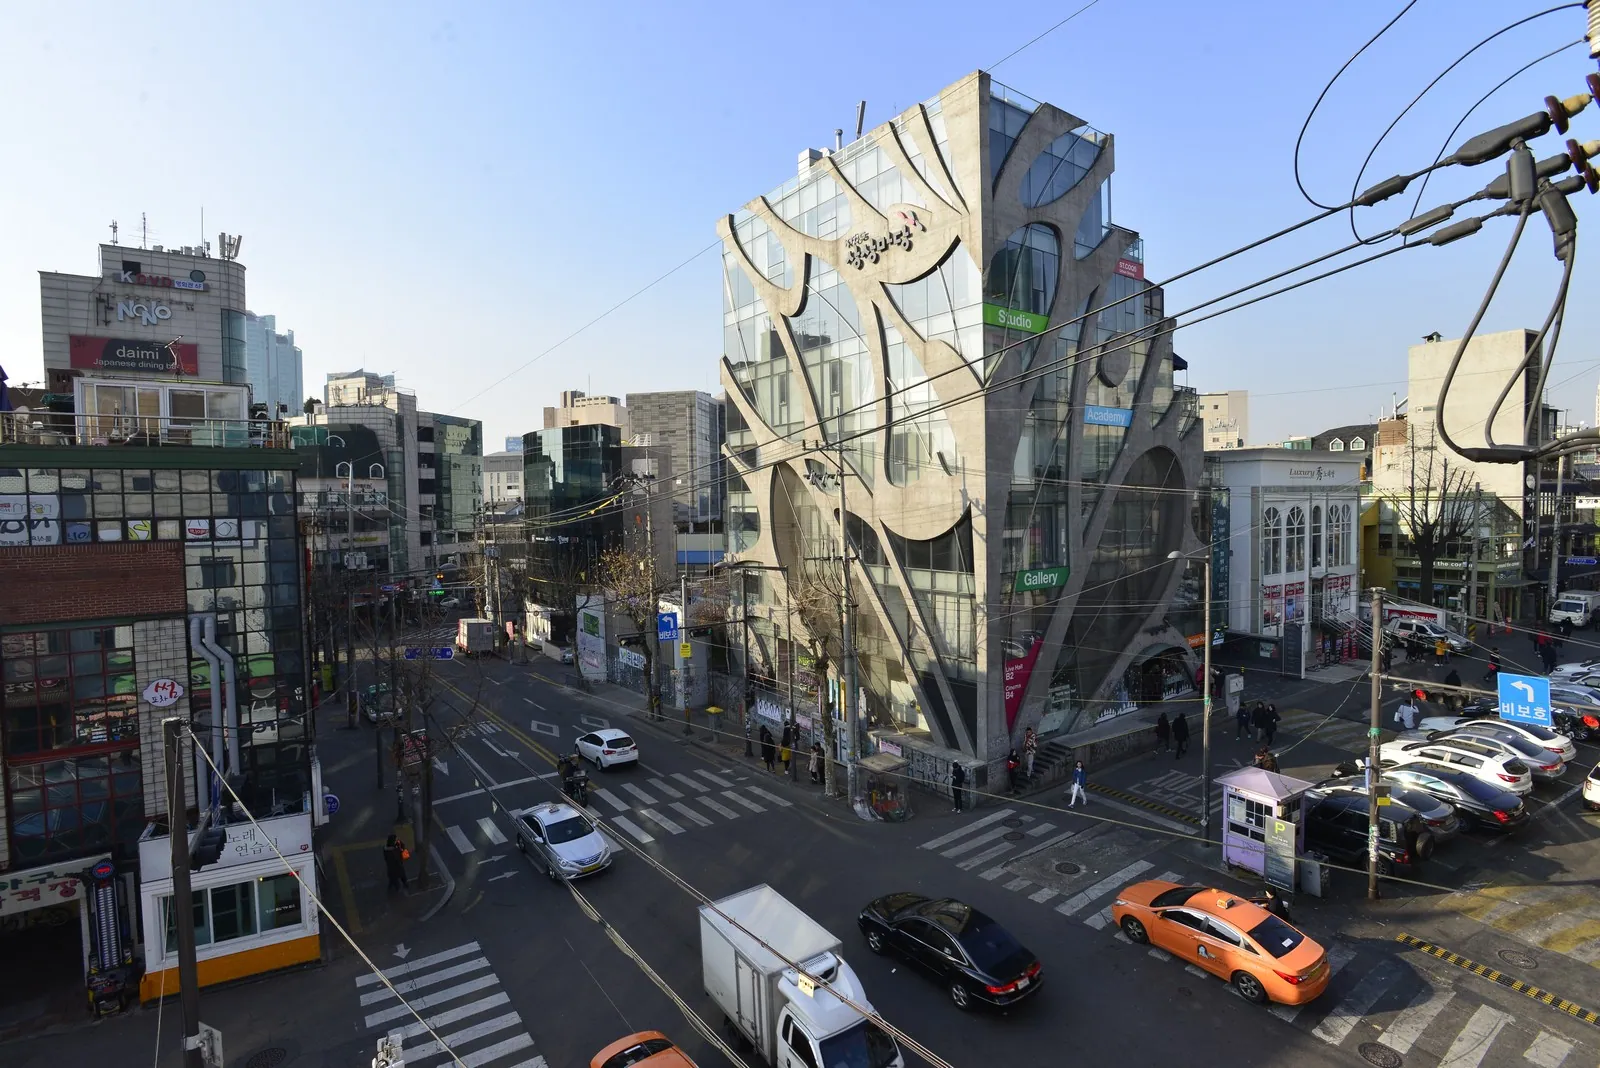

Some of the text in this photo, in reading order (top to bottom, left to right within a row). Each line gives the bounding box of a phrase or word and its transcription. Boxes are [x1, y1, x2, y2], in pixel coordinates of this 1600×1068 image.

[847, 225, 913, 270] 상상마당
[998, 309, 1032, 328] Studio
[116, 346, 159, 360] daimi
[93, 358, 136, 368] Japanese
[138, 361, 164, 370] dining
[1087, 408, 1126, 424] Academy
[1289, 468, 1316, 477] Luxury
[1024, 572, 1058, 586] Gallery
[659, 630, 678, 640] 비보호
[1006, 672, 1014, 681] B2
[1005, 684, 1022, 692] Cinema
[152, 694, 168, 704] 포차
[1006, 692, 1014, 700] B4
[1502, 702, 1548, 721] 비보호
[1275, 822, 1286, 834] P
[228, 828, 256, 844] 노래
[235, 838, 278, 856] 연습실
